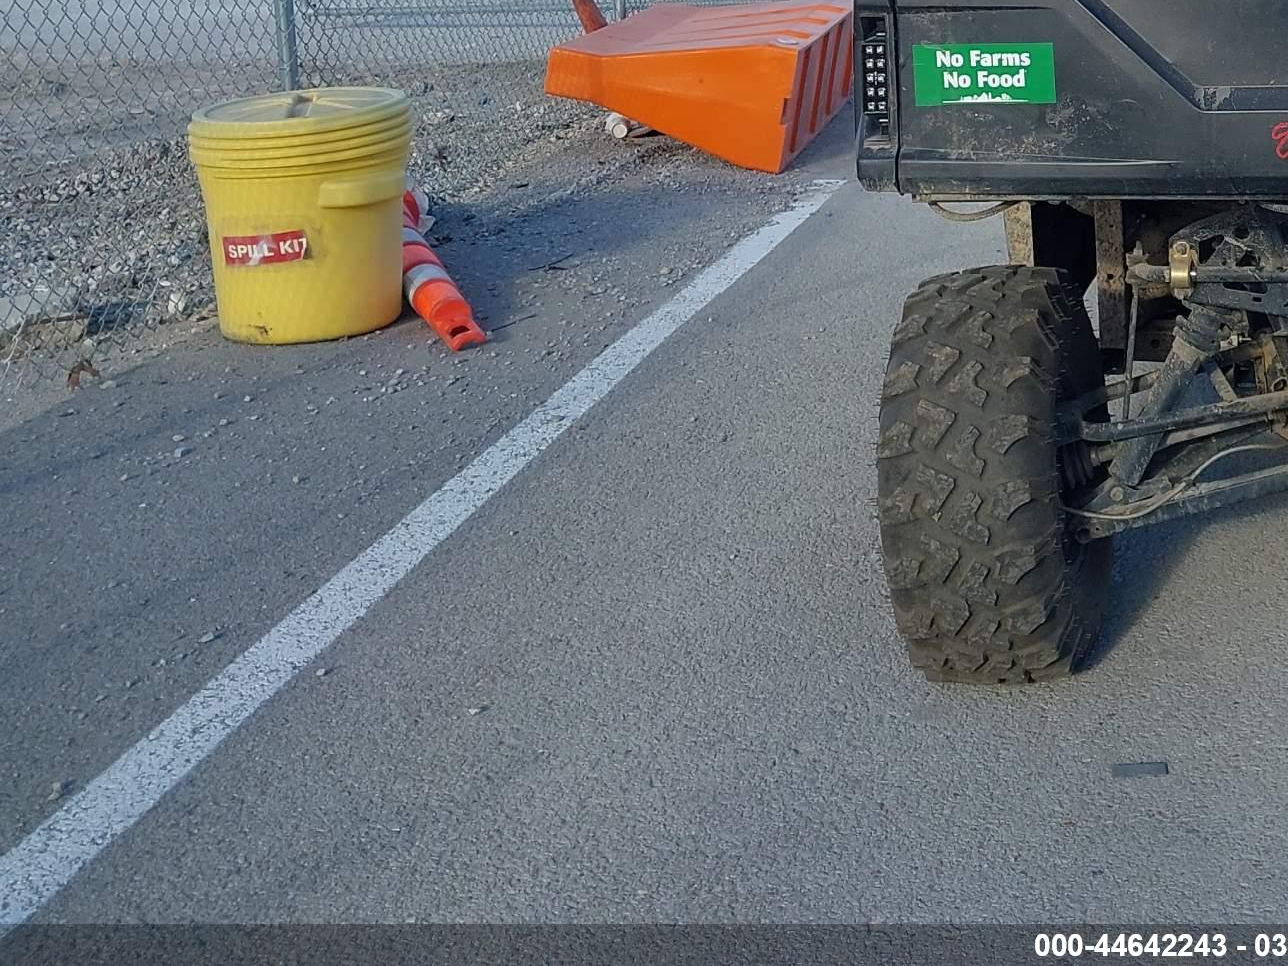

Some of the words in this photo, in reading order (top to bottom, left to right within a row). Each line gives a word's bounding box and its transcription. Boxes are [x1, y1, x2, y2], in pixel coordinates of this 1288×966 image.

[936, 50, 963, 67] No
[970, 49, 1031, 67] Farms
[943, 71, 971, 88] No
[977, 69, 1026, 88] Food
[228, 243, 275, 259] SPILL
